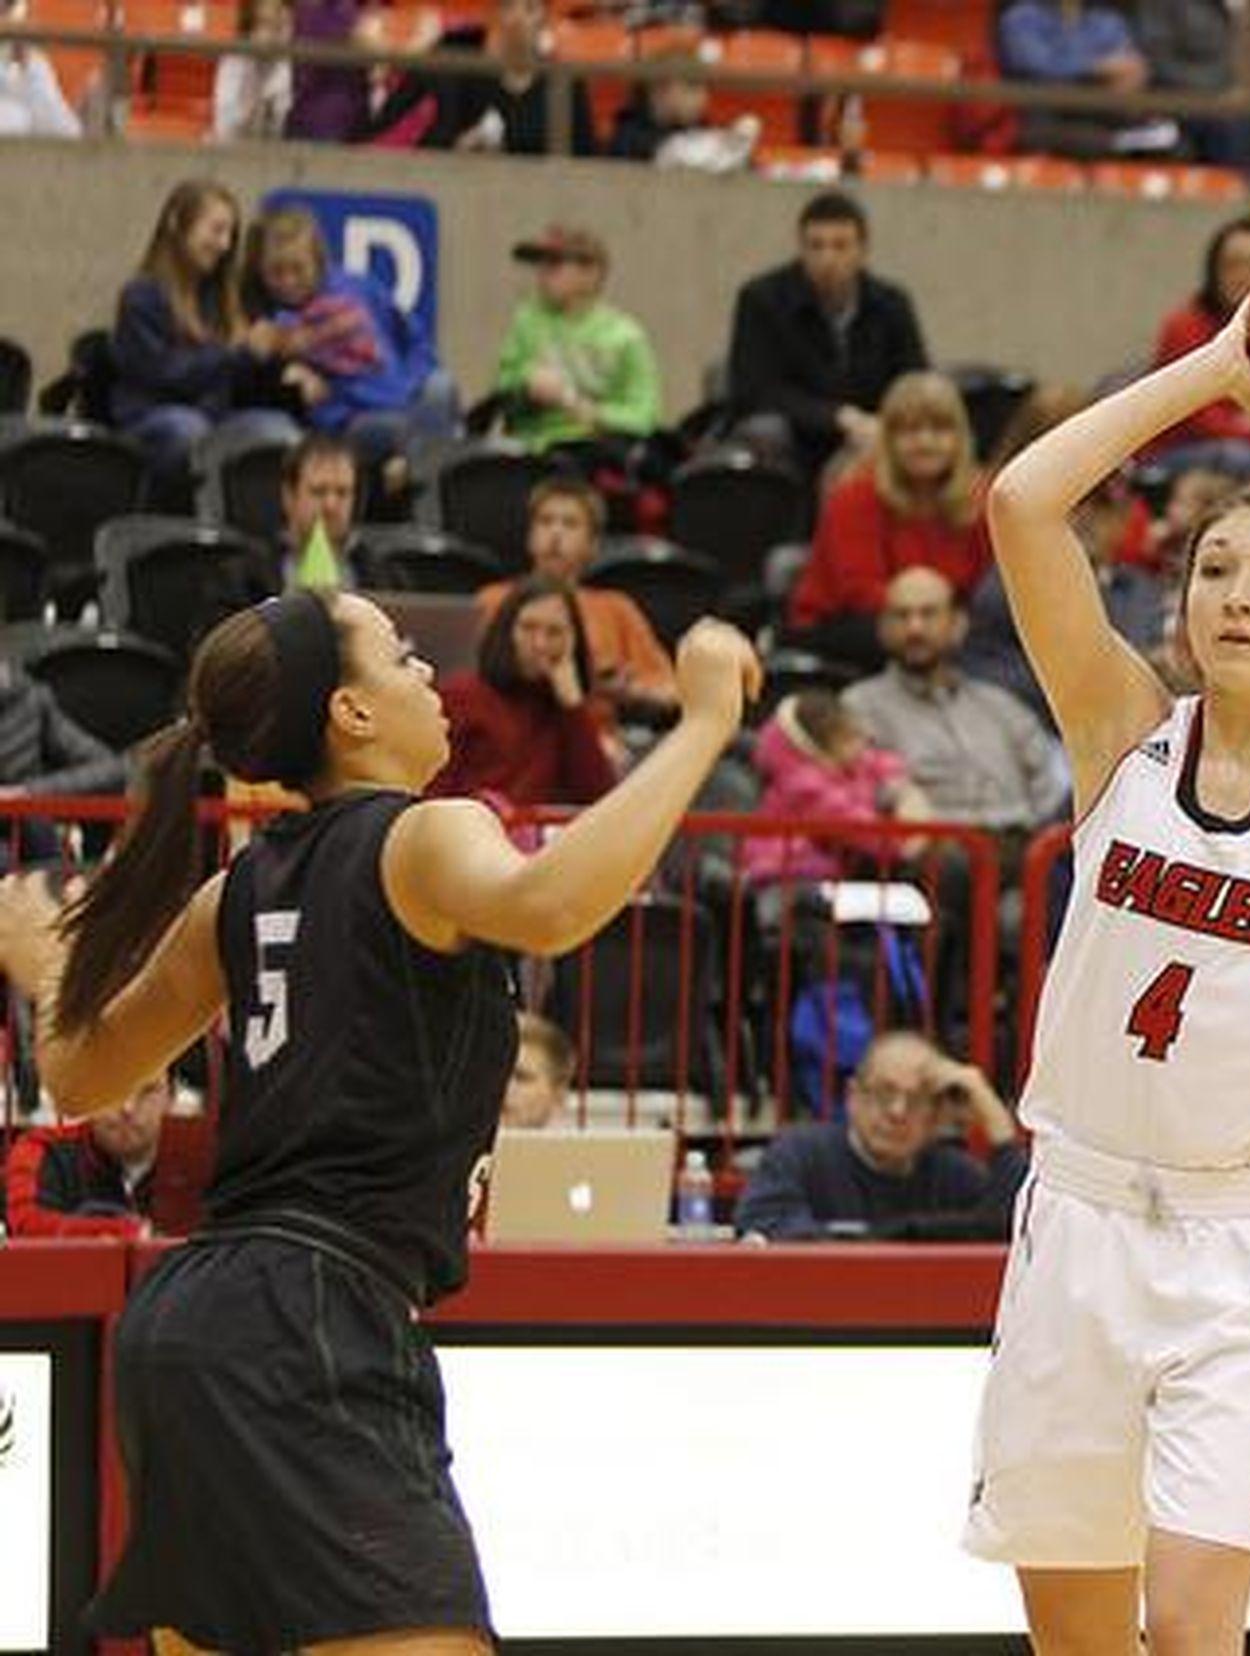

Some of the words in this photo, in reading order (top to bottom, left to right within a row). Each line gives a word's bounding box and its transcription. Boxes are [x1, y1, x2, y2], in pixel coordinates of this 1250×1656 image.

[343, 215, 424, 313] D
[245, 910, 301, 1069] 5
[1125, 960, 1196, 1062] 4
